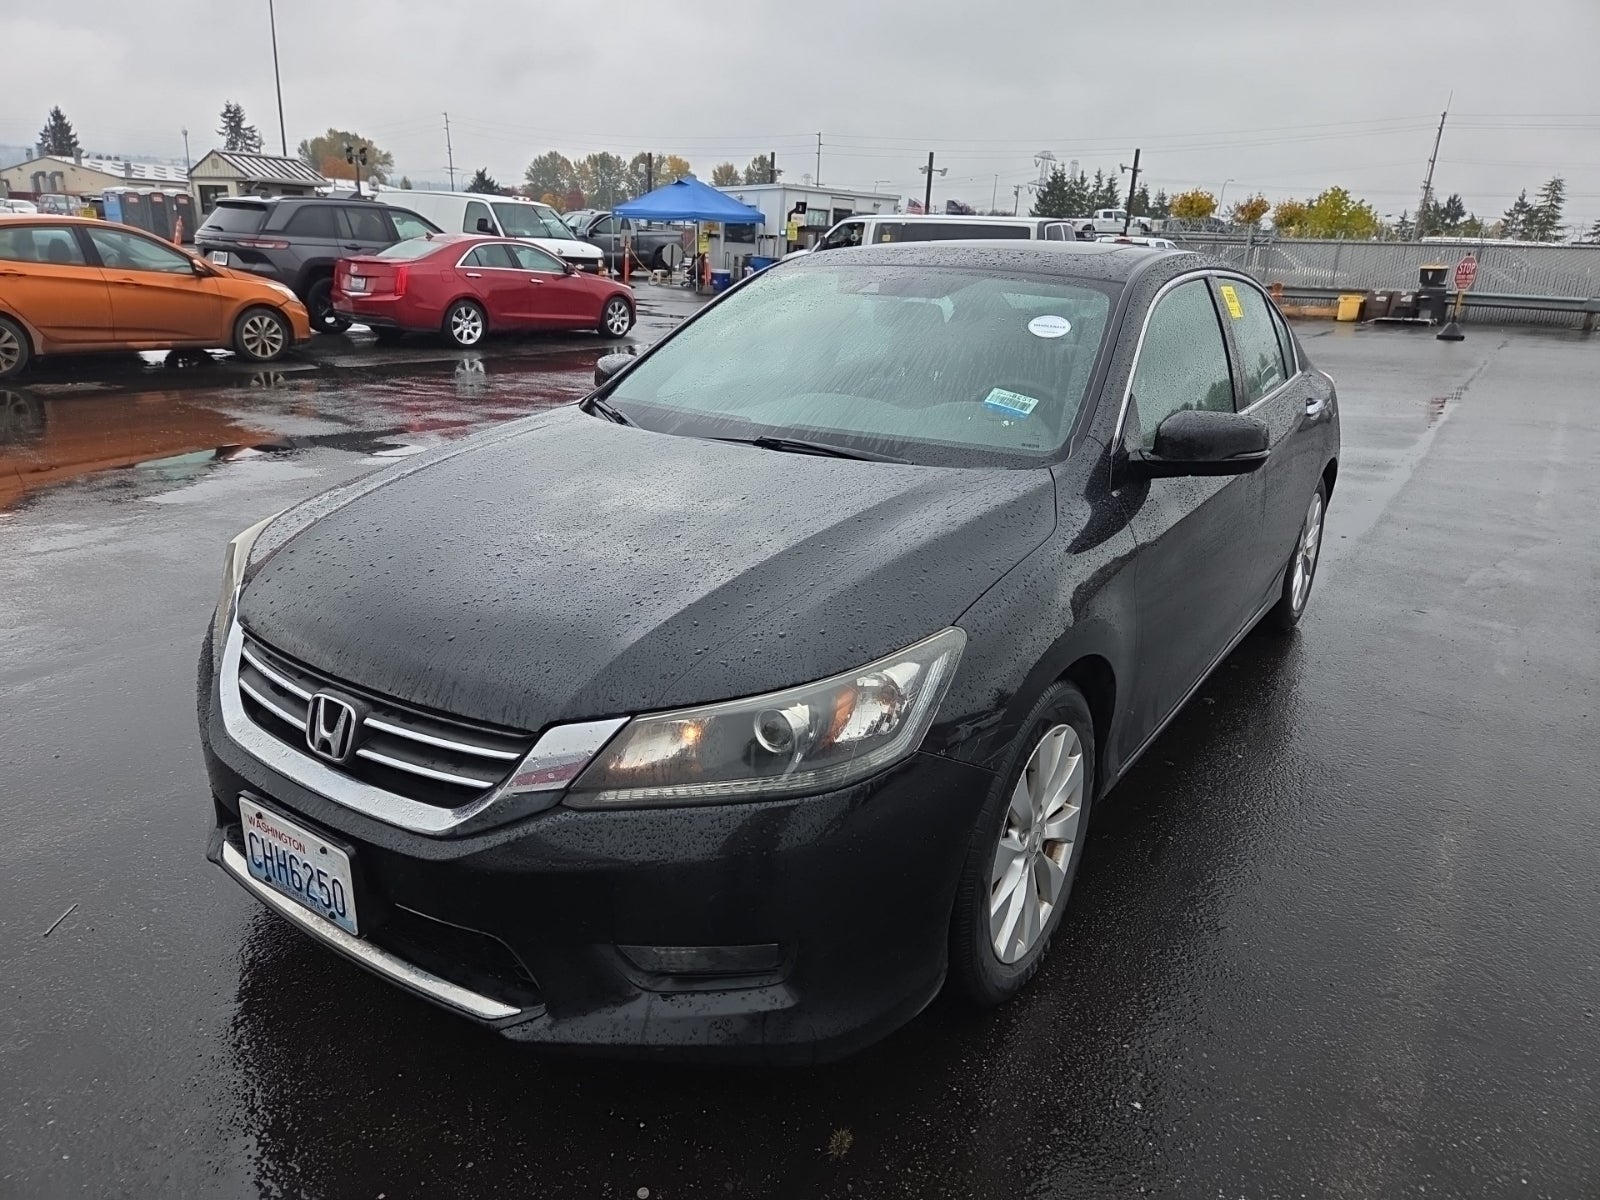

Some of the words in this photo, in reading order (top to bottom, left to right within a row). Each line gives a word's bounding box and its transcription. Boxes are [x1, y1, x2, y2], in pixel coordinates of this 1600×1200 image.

[1458, 263, 1476, 274] STOP
[247, 816, 306, 855] WASHINGTON
[248, 831, 346, 918] CHH6250
